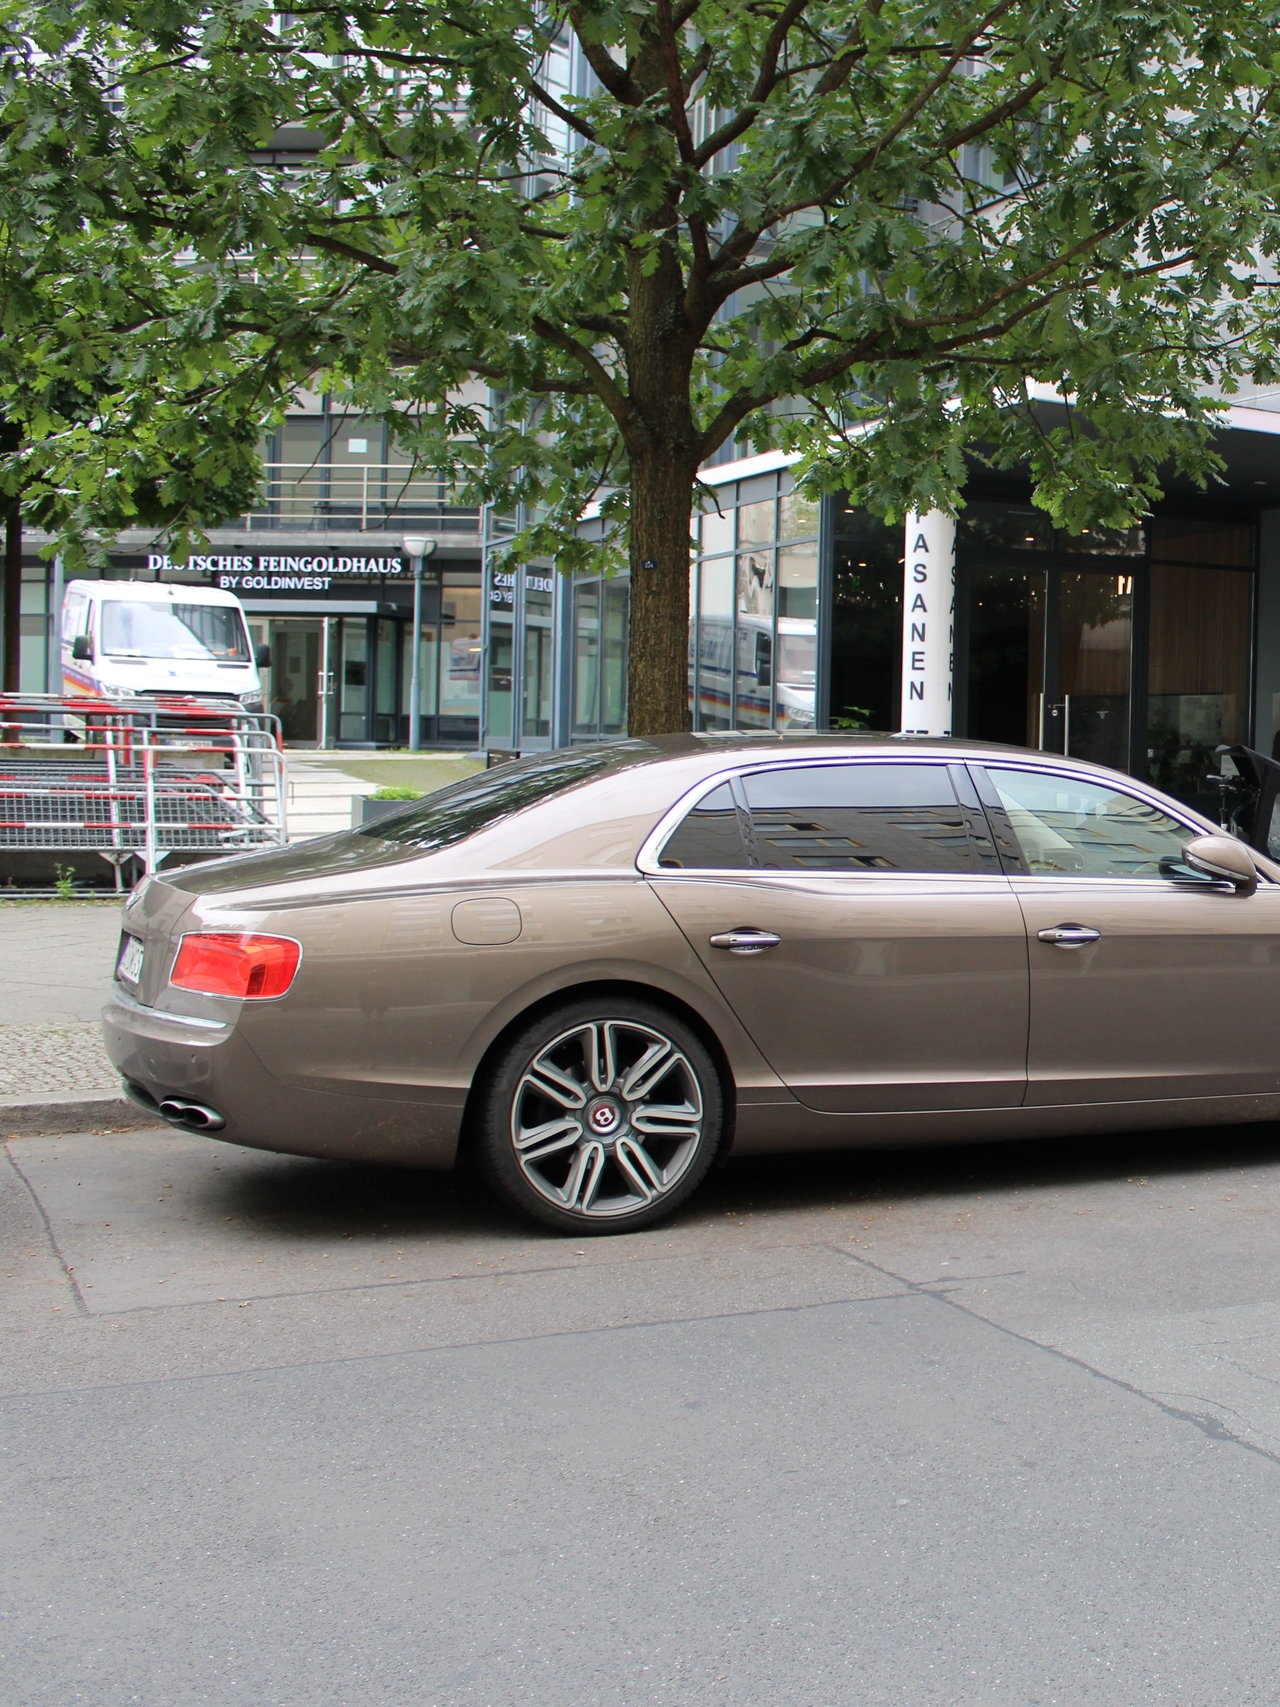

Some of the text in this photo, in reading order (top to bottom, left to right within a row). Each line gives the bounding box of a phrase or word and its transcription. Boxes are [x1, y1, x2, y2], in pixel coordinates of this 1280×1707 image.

[148, 555, 402, 573] DETSCHES FEINGOLDHAUS
[220, 576, 332, 590] BY GOLDINVEST
